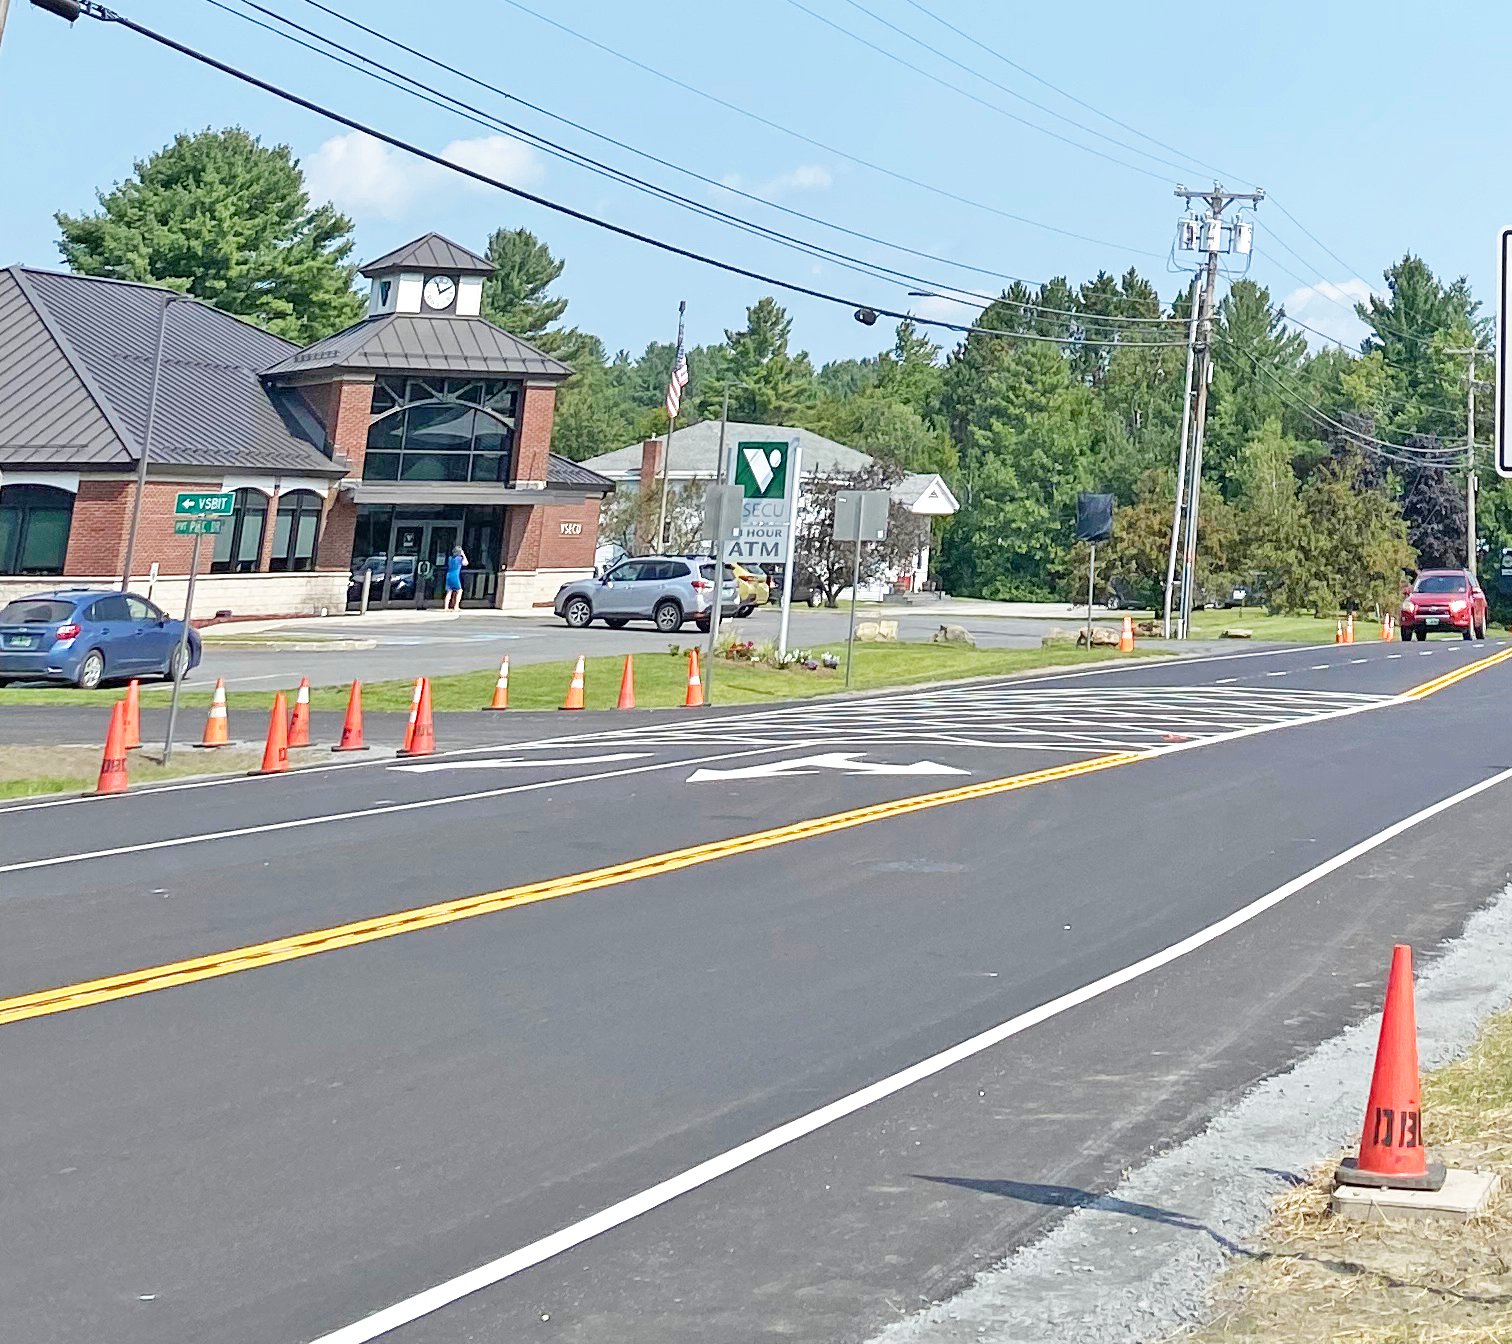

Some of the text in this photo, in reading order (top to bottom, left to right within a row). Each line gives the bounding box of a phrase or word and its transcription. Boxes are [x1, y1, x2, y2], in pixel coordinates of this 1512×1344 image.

[199, 498, 228, 510] VSBIT
[743, 503, 784, 517] SECU
[747, 529, 782, 537] HOUR
[729, 542, 779, 556] ATM
